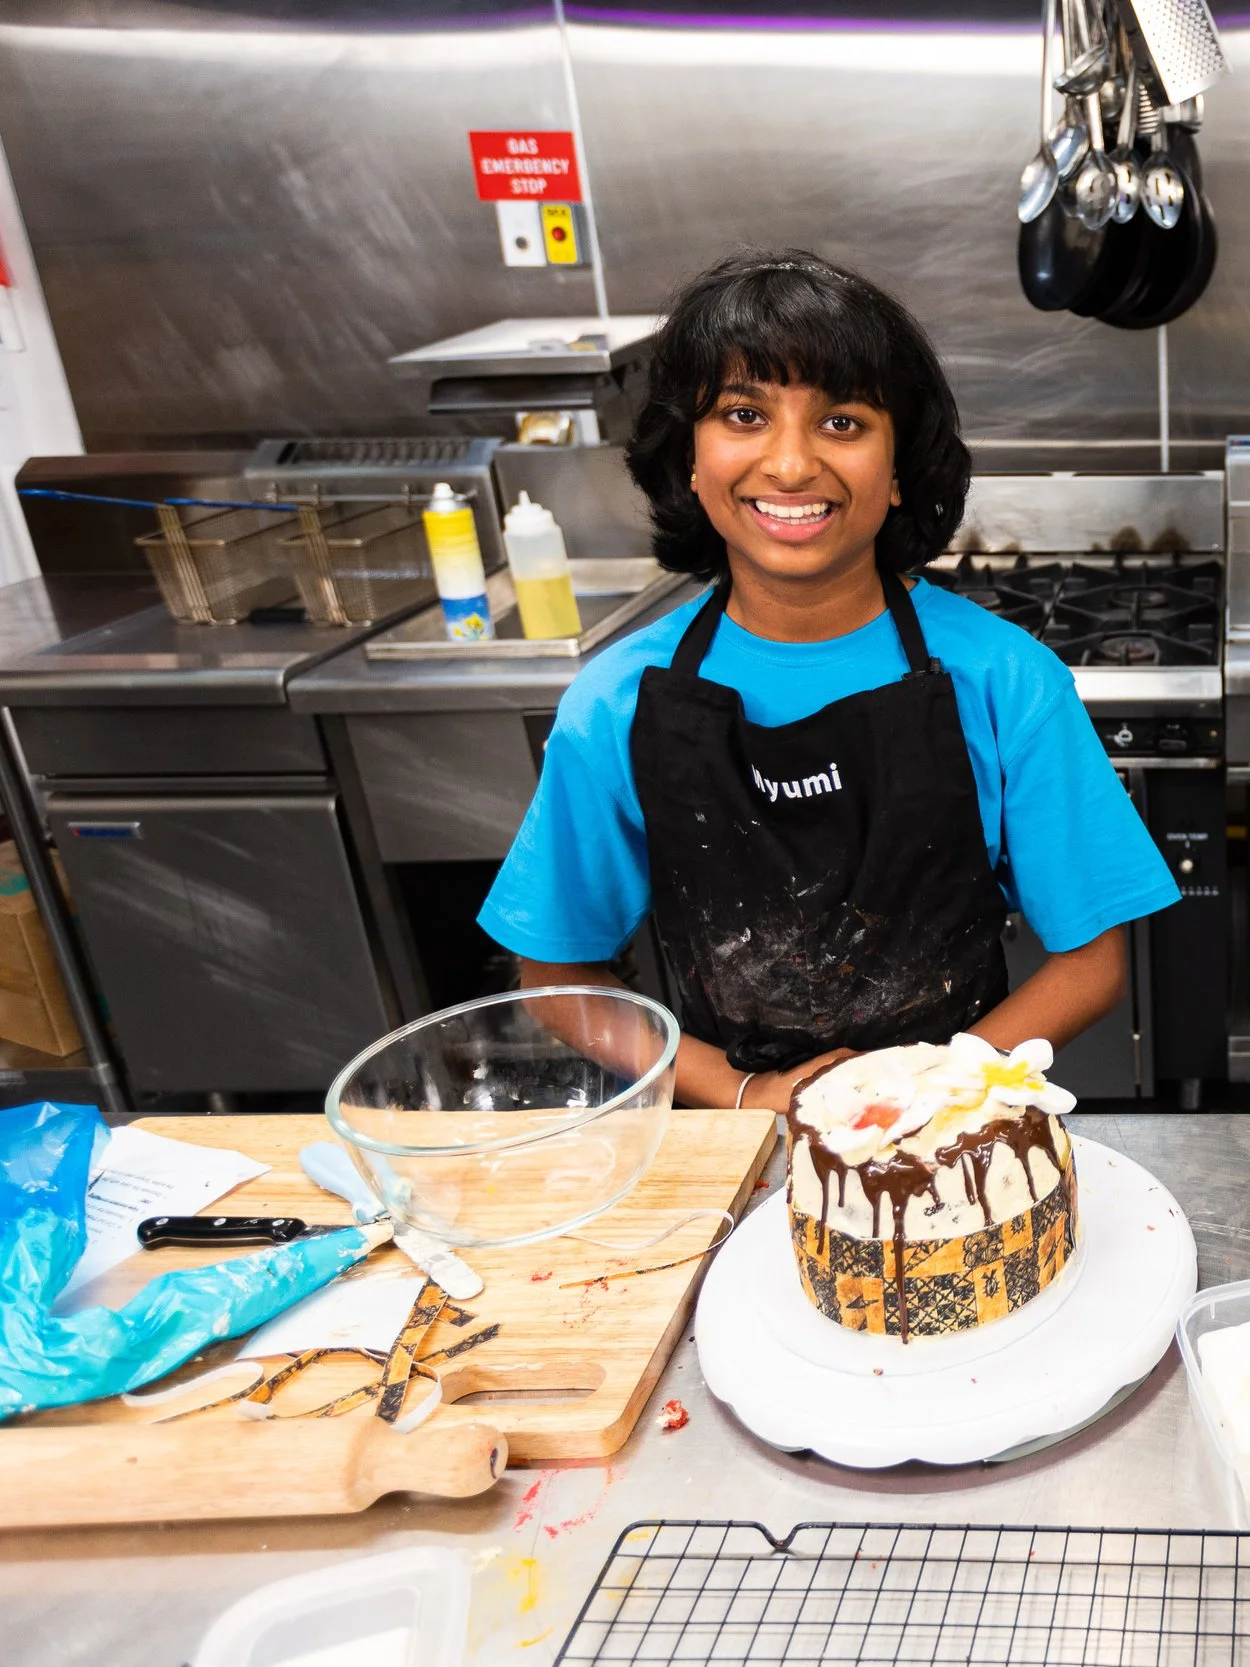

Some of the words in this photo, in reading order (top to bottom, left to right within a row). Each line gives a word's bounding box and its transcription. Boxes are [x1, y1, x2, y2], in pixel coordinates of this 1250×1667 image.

[507, 138, 538, 154] GAS
[481, 158, 568, 174] EMERGENCY
[511, 178, 547, 194] STOP
